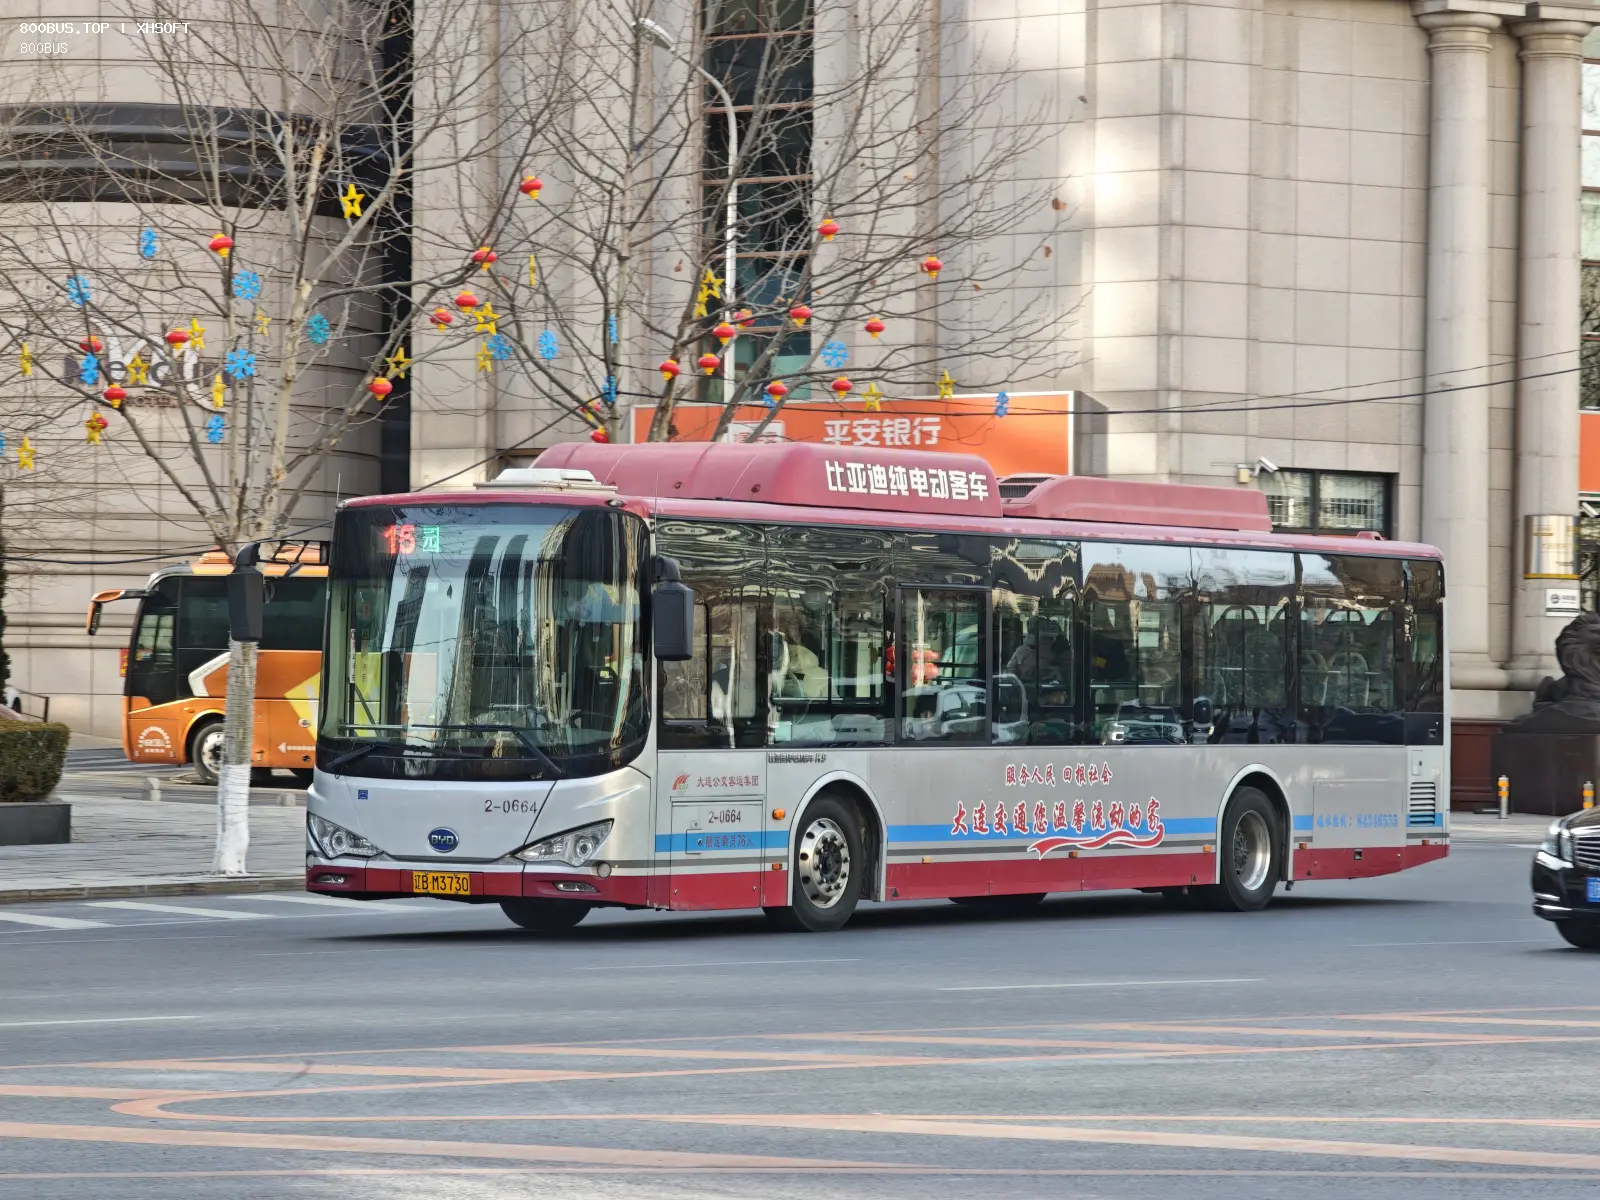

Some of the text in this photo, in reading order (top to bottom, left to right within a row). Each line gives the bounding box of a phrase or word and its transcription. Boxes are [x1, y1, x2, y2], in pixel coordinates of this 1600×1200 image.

[823, 417, 942, 446] 平安银行
[825, 460, 989, 501] 比亚迪纯电动客车
[383, 524, 416, 554] 15
[697, 775, 759, 788] 大连公交客运集团
[1005, 761, 1113, 787] 服务人民 回报社会
[484, 799, 538, 815] 2-0664
[708, 809, 742, 824] 2-0664
[951, 797, 1161, 835] 大连交通您温馨流动的家
[431, 834, 454, 845] BYD
